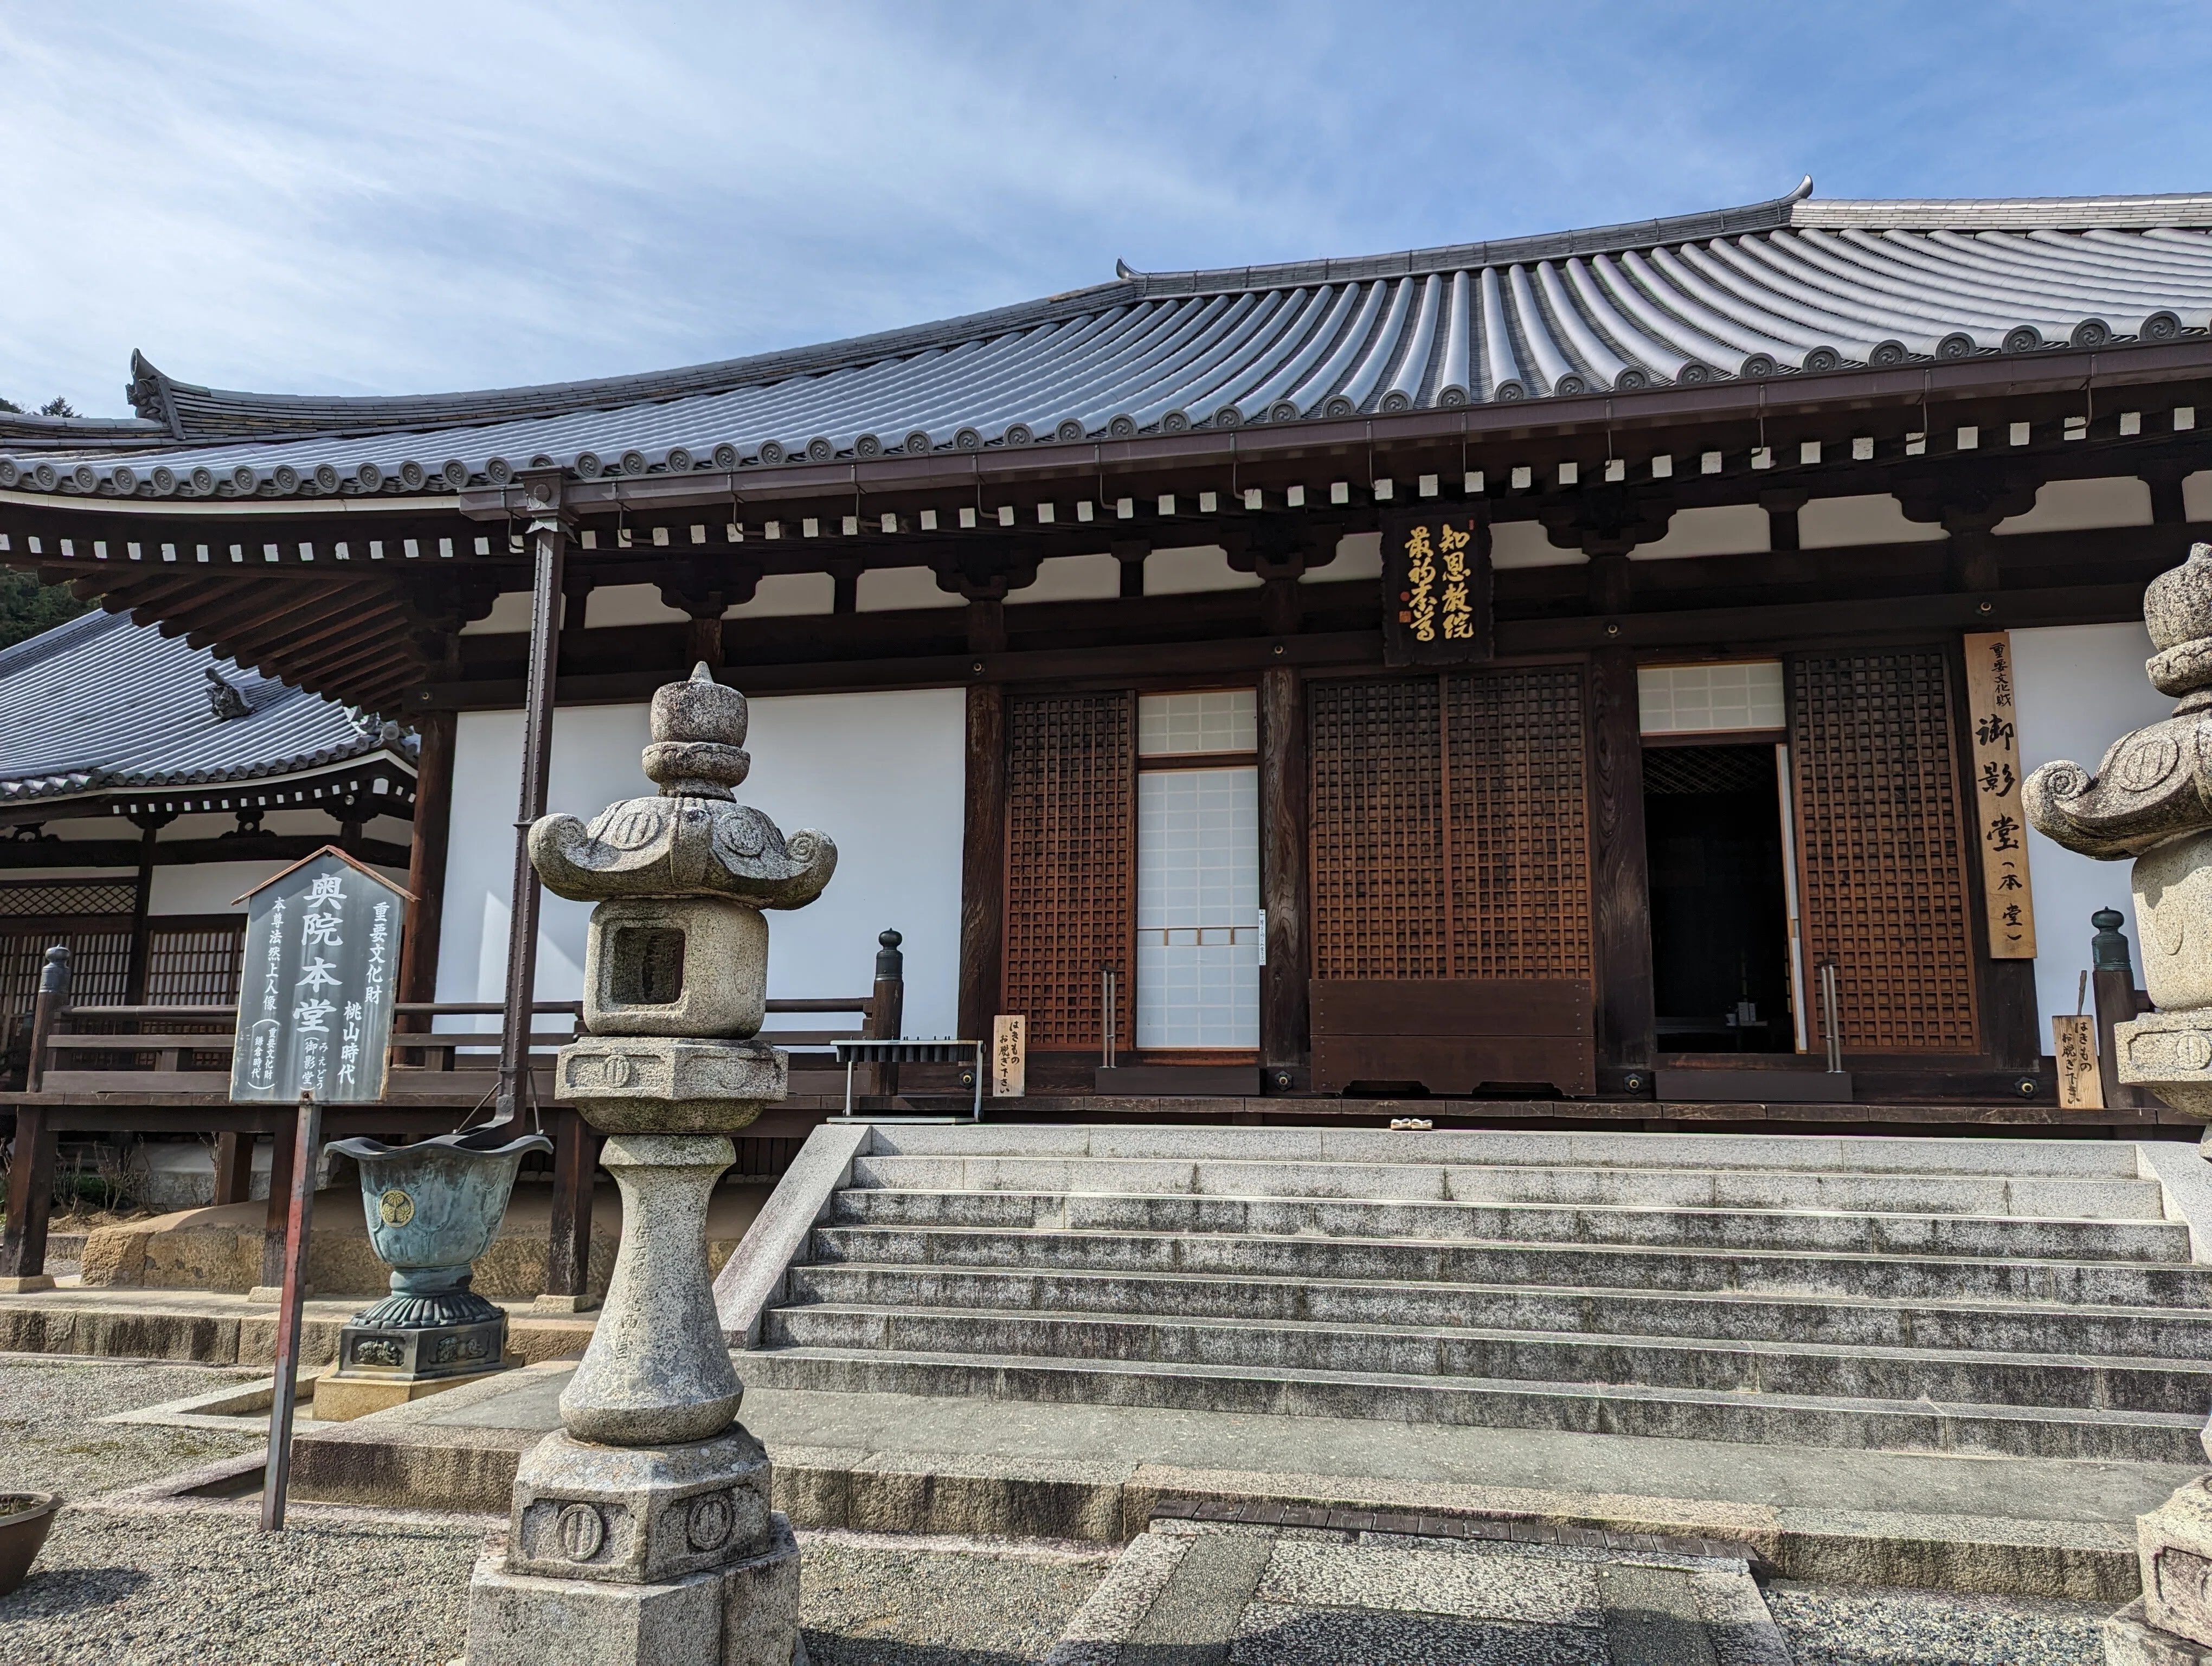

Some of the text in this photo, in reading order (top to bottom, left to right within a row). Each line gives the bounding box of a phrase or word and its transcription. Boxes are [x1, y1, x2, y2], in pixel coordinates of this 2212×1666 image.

[1989, 642, 2011, 707] 重要文化財
[263, 896, 286, 1011] 本尊法然上人像
[292, 873, 347, 1033] 奥院本堂
[364, 901, 390, 1005] 重要文化財
[251, 1036, 264, 1079] 鎌倉時代
[263, 1027, 277, 1080] 重要文化財
[317, 1042, 329, 1090] みえどう
[337, 1001, 362, 1085] 桃山時代
[998, 1034, 1010, 1094] お脱ぎ下さい
[1009, 1020, 1020, 1065] はきもの
[2061, 1033, 2080, 1104] お脱ぎ下さい
[2074, 1022, 2092, 1072] はきもの
